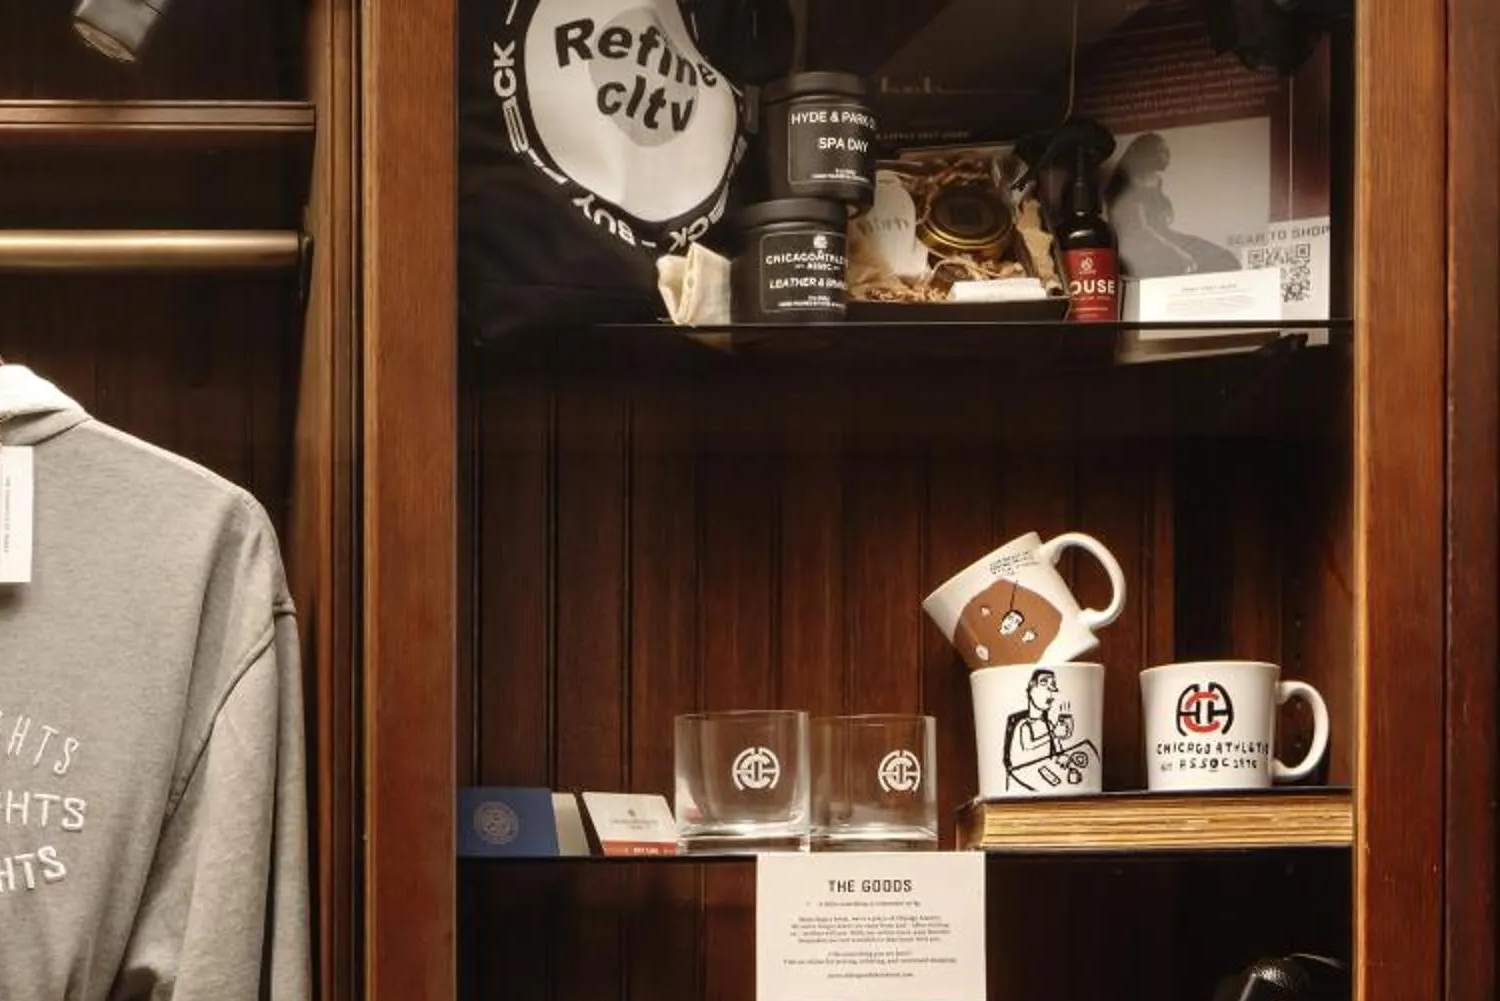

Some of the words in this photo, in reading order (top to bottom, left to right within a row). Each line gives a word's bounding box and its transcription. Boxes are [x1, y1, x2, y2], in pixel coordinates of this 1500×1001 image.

[791, 111, 828, 125] HYDE
[830, 112, 840, 123] &
[818, 137, 845, 149] SPA
[847, 138, 869, 152] DAY
[572, 194, 637, 247] BUY
[1270, 230, 1287, 241] TO
[769, 277, 817, 289] LEATHER
[1070, 279, 1116, 296] OUSE
[828, 880, 856, 893] THE
[861, 879, 913, 893] GOODS
